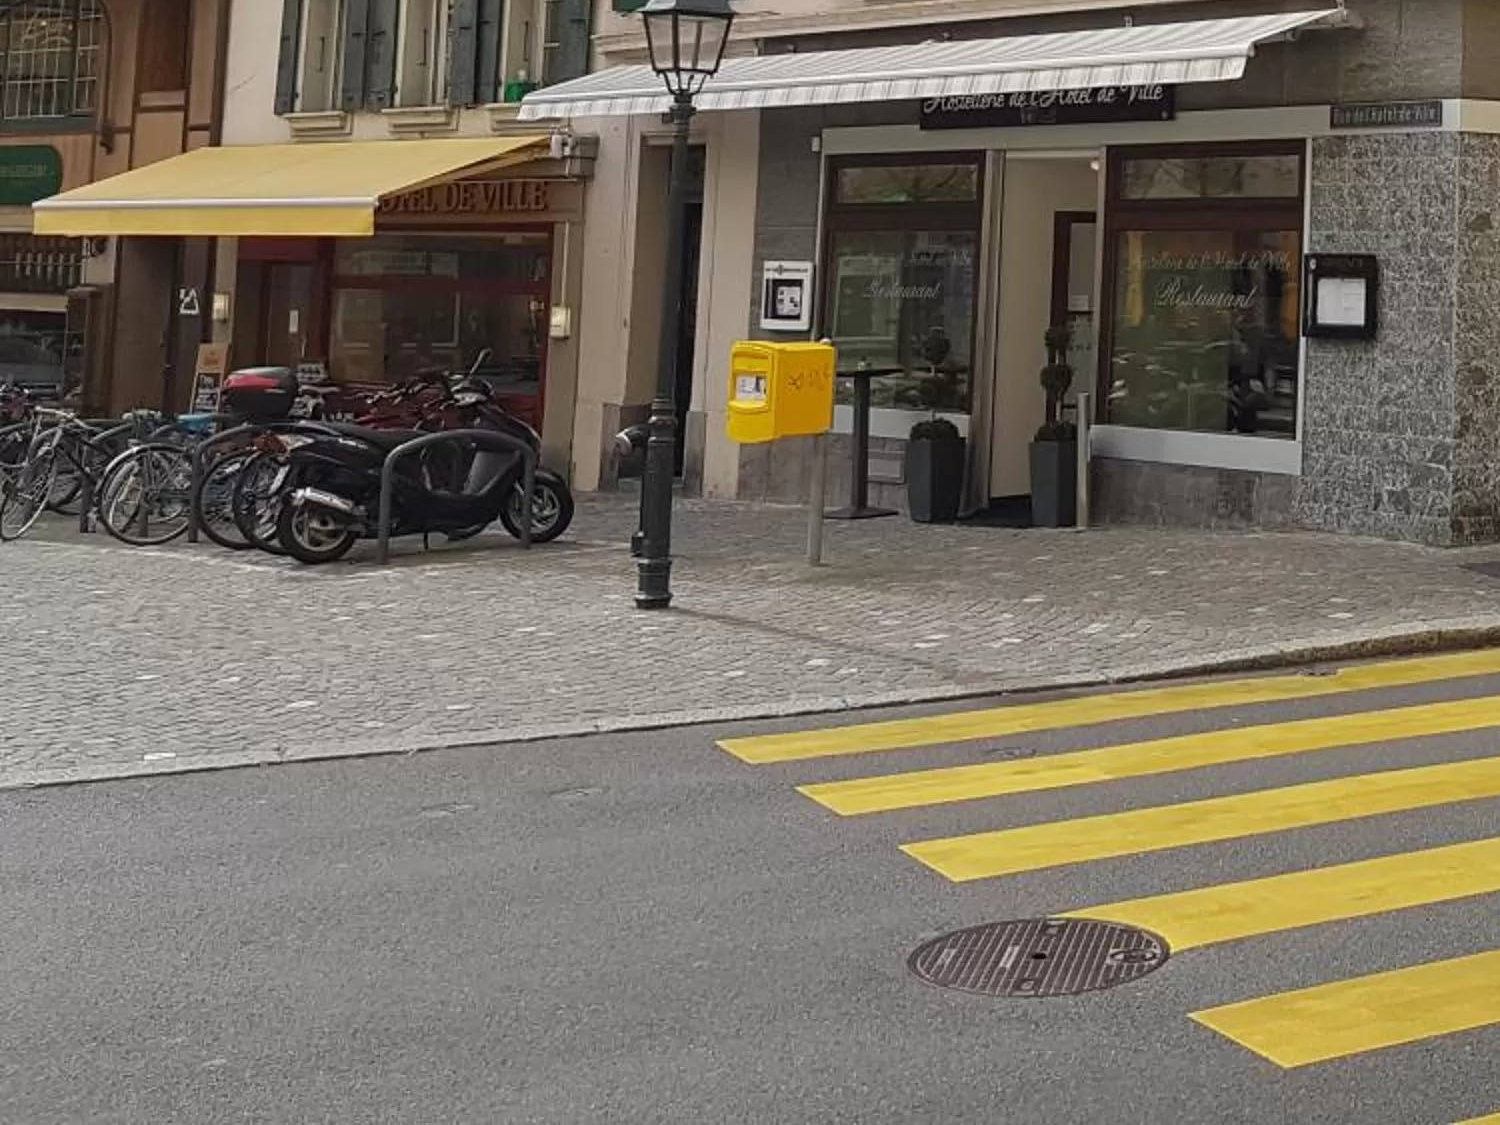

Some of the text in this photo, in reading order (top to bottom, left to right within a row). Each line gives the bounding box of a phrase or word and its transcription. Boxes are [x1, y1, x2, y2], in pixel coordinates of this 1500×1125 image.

[1097, 86, 1116, 103] de
[444, 183, 474, 211] DE
[482, 179, 548, 211] VILLE
[1153, 277, 1260, 308] Restaurant
